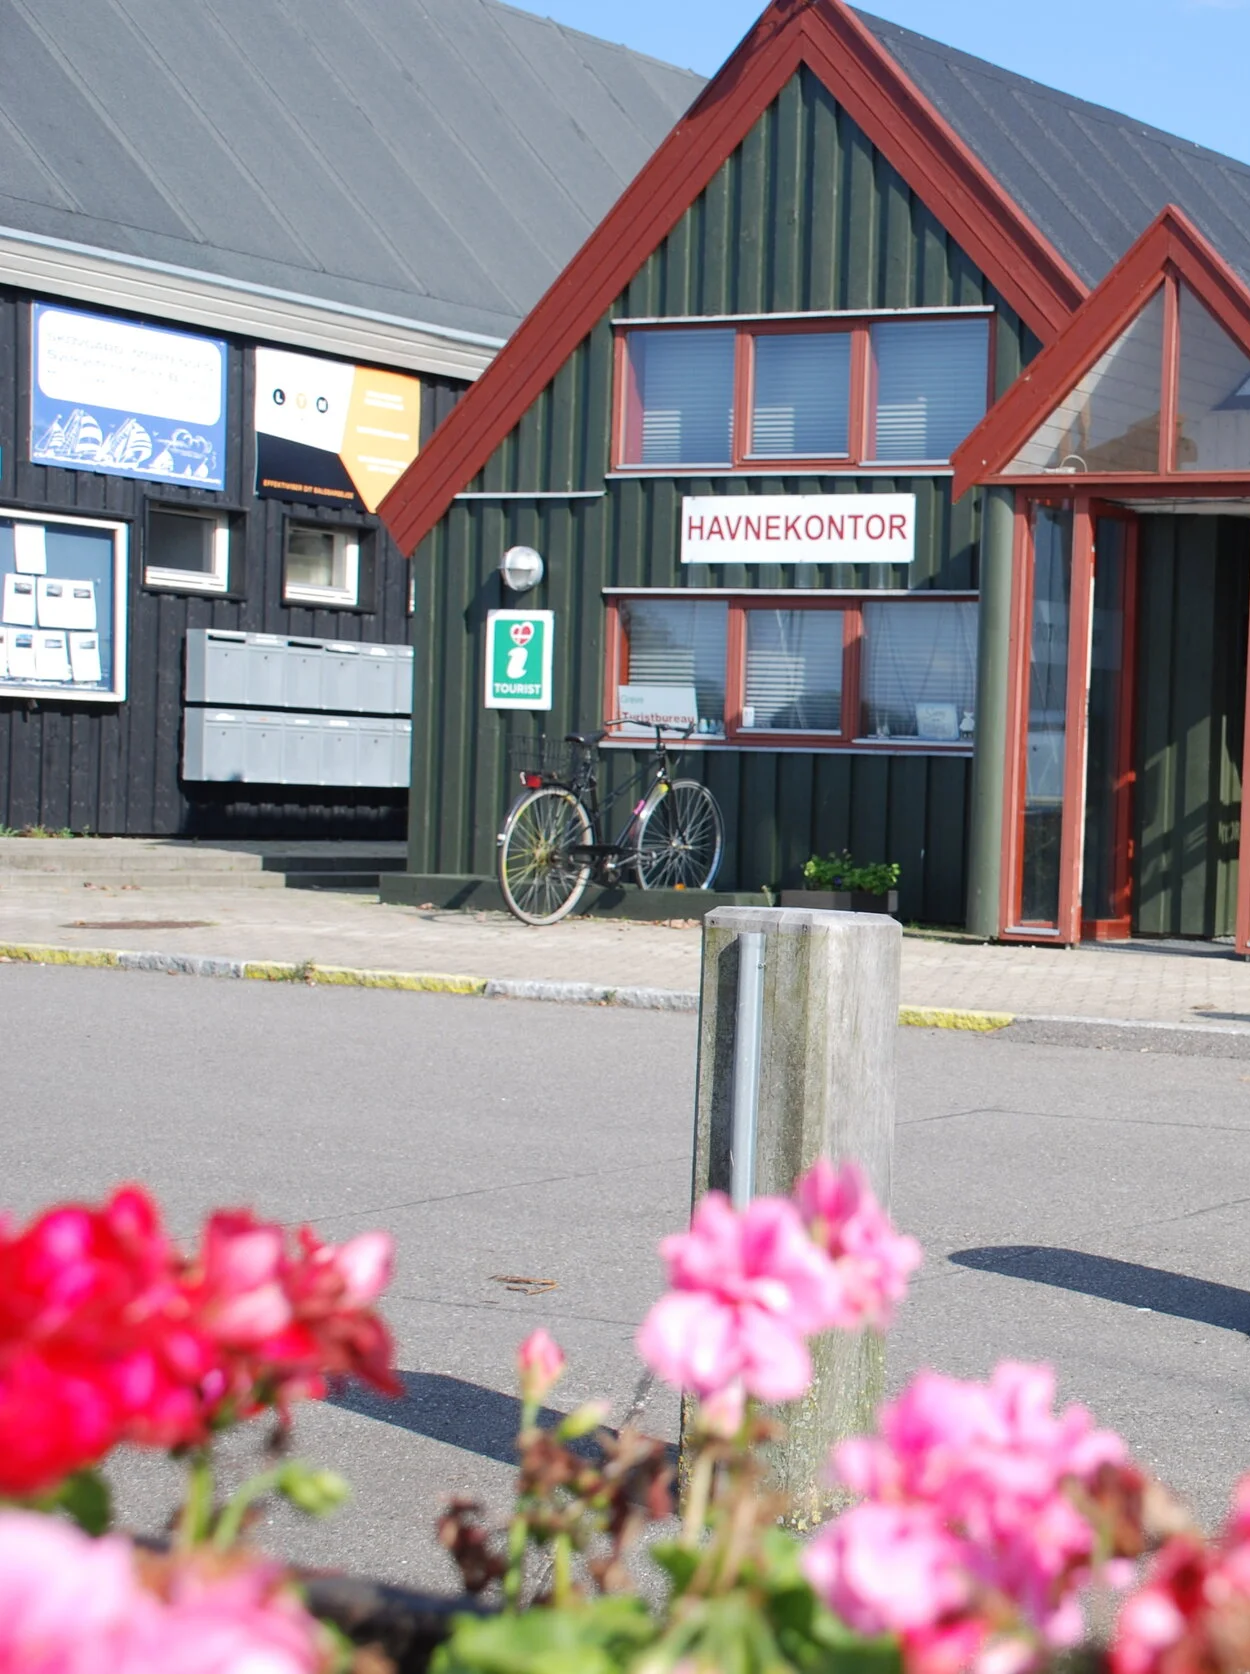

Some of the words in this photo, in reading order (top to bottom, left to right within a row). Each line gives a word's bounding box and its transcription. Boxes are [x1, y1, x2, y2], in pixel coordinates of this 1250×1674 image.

[688, 514, 907, 541] HAVNEKONTOR
[494, 682, 542, 696] TOURIST
[621, 711, 695, 724] Turistbureau
